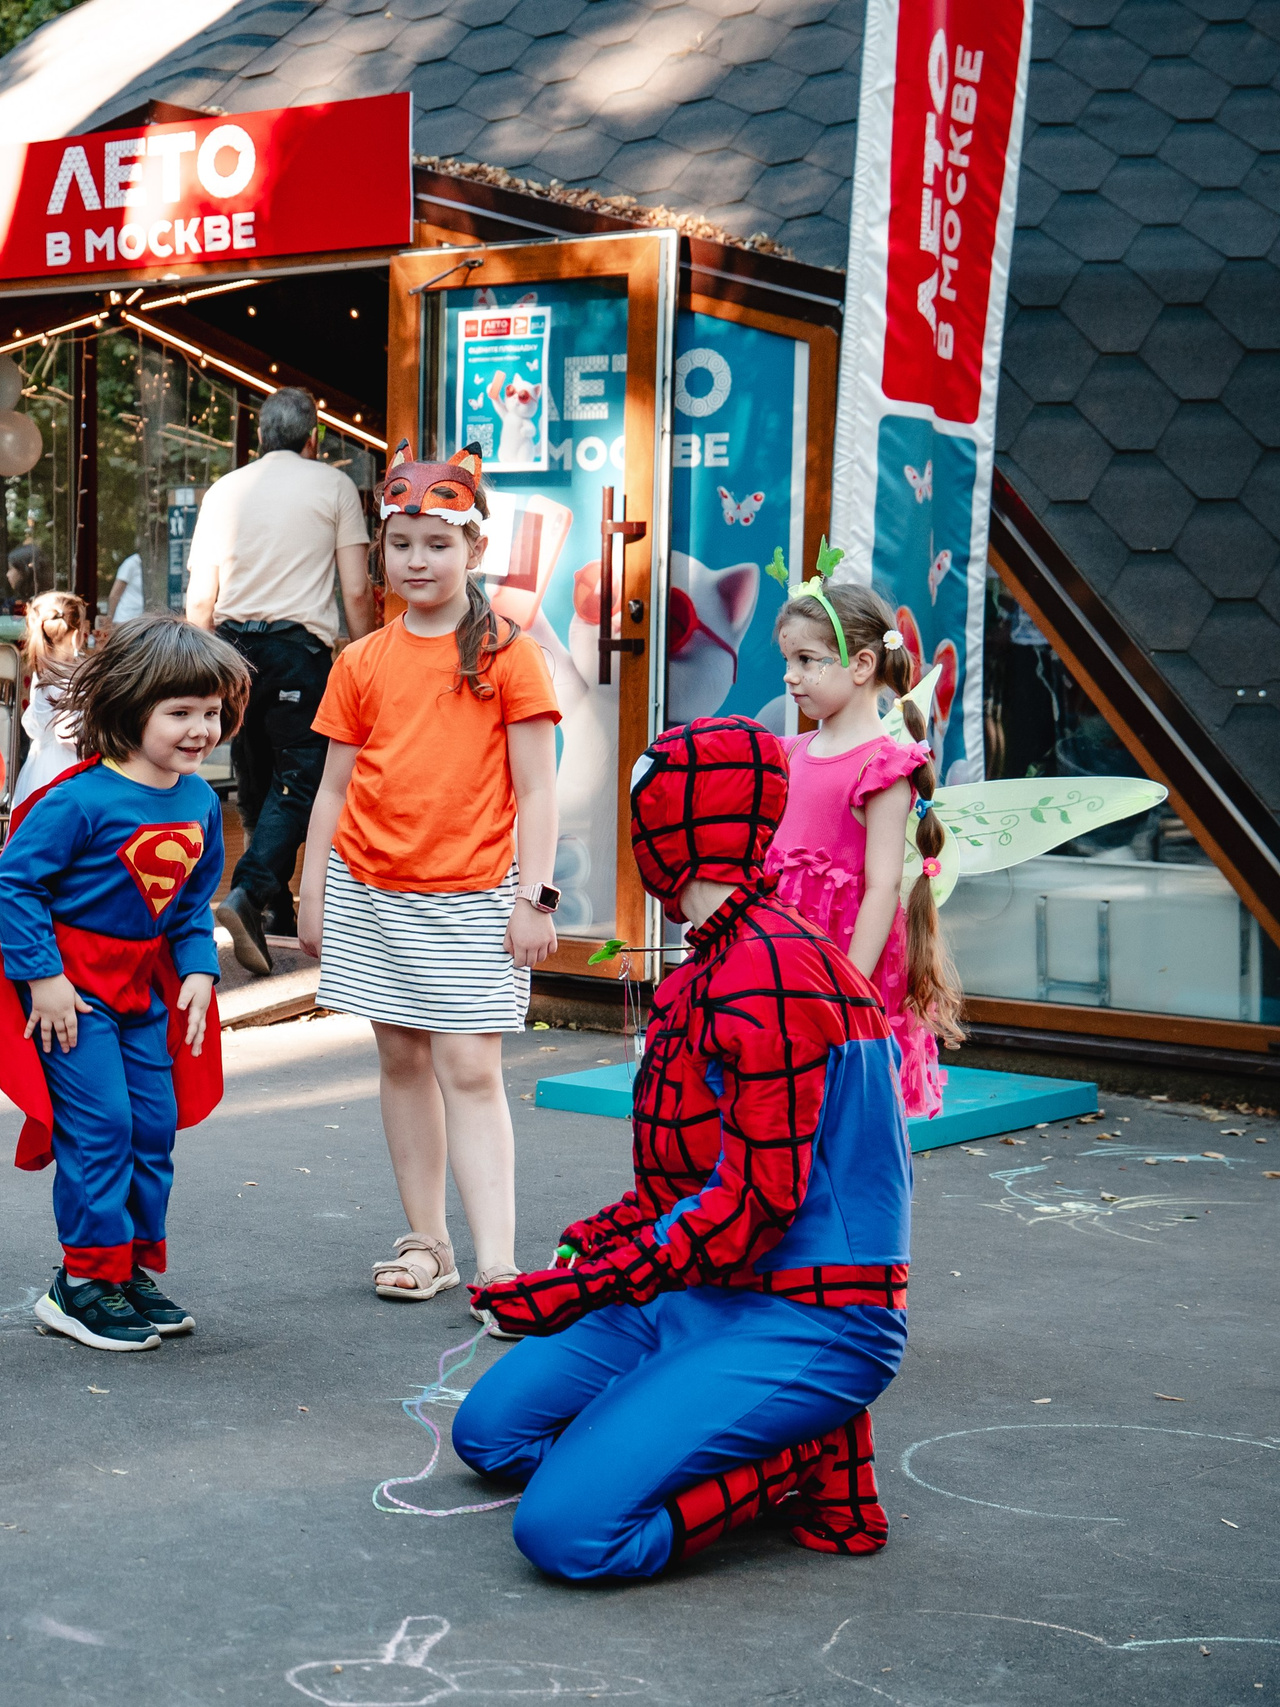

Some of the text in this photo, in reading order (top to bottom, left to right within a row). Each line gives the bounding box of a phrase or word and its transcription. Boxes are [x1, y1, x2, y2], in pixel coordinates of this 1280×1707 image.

[46, 124, 256, 215] ЛЕТО
[917, 27, 949, 348] ЛЕТО
[937, 44, 984, 361] В МОСКВЕ
[46, 212, 257, 266] В МОСКВЕ
[484, 320, 508, 329] ЛЕТО
